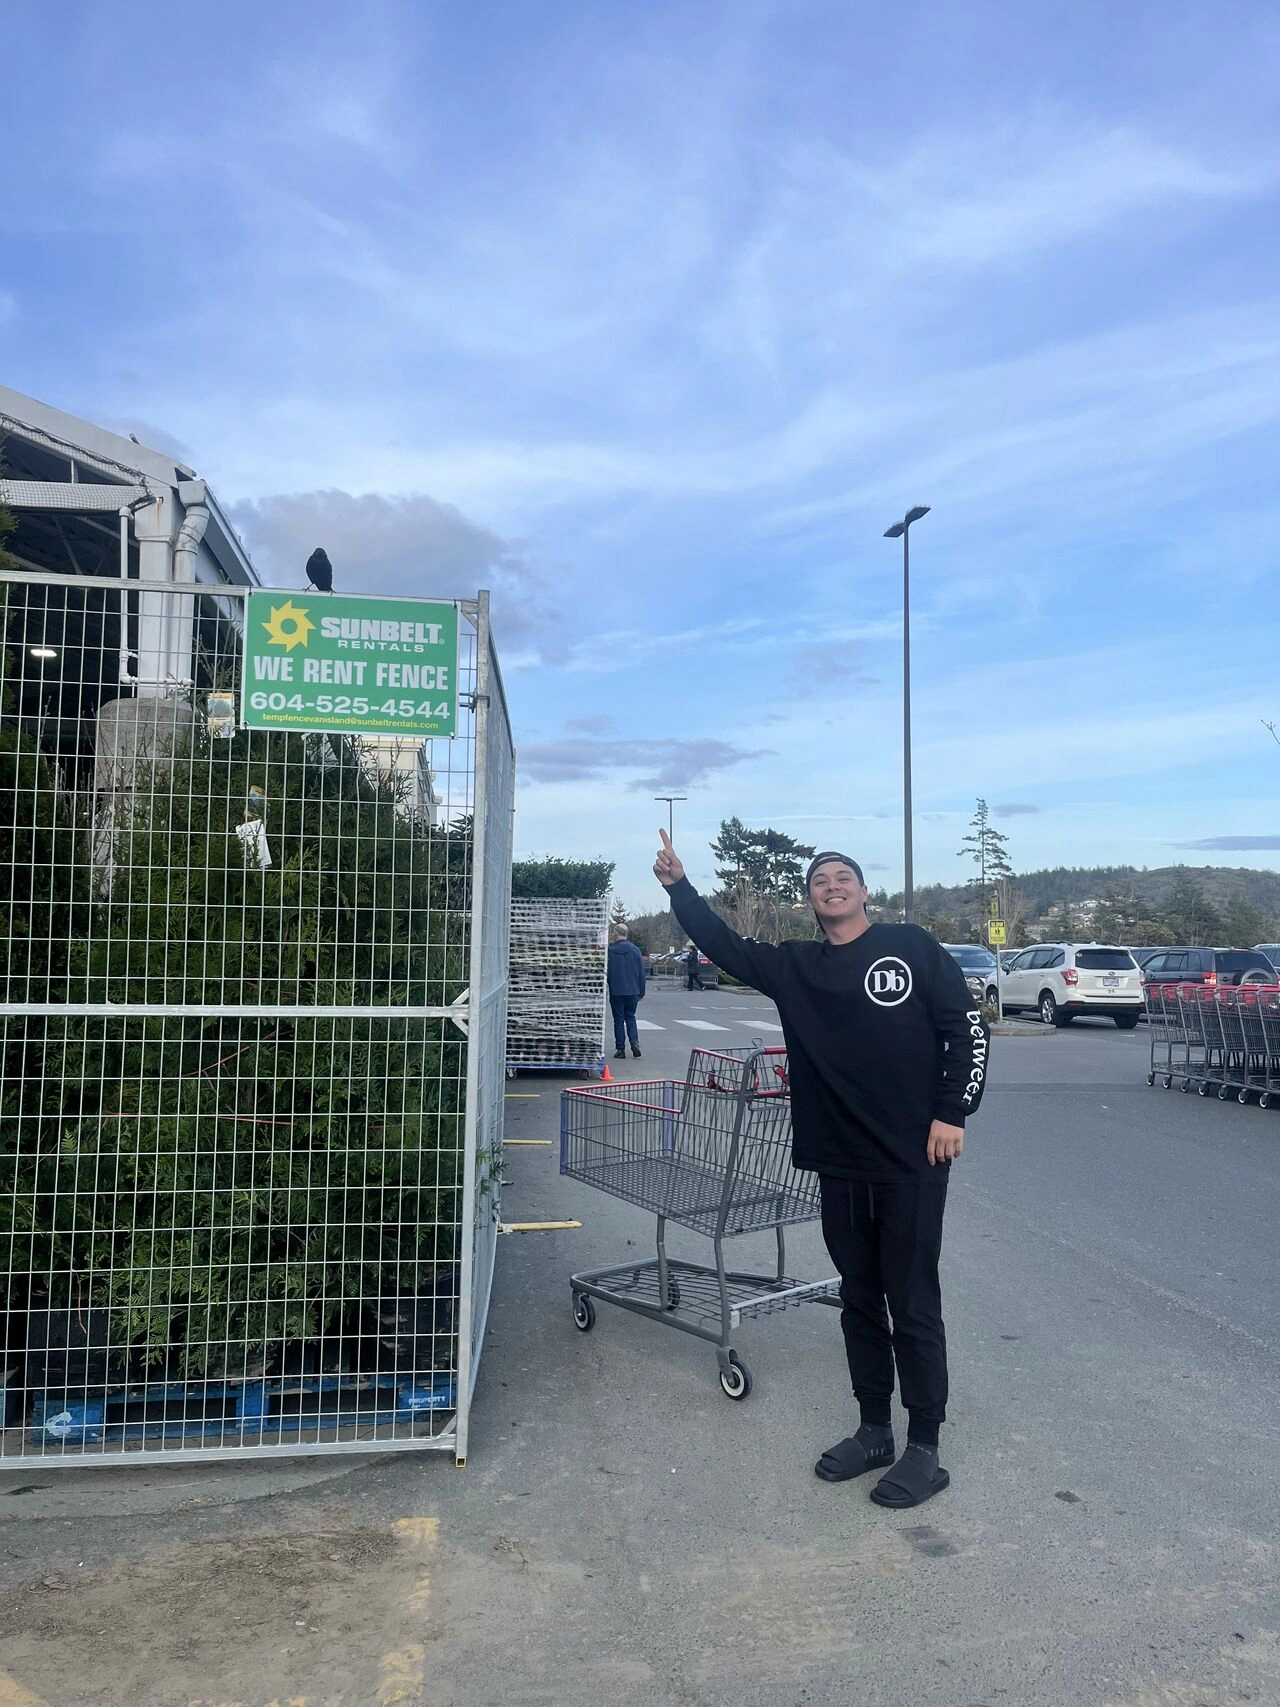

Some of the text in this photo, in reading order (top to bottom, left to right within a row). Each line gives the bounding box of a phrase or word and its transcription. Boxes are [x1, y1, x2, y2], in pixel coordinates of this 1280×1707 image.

[321, 617, 443, 644] SUNBELT
[338, 640, 425, 653] RENTALS
[254, 656, 449, 690] WE RENT FENCE
[250, 692, 450, 719] 604-525-4544
[263, 713, 439, 729] tempfencevanisland@sunbeltrentals.com
